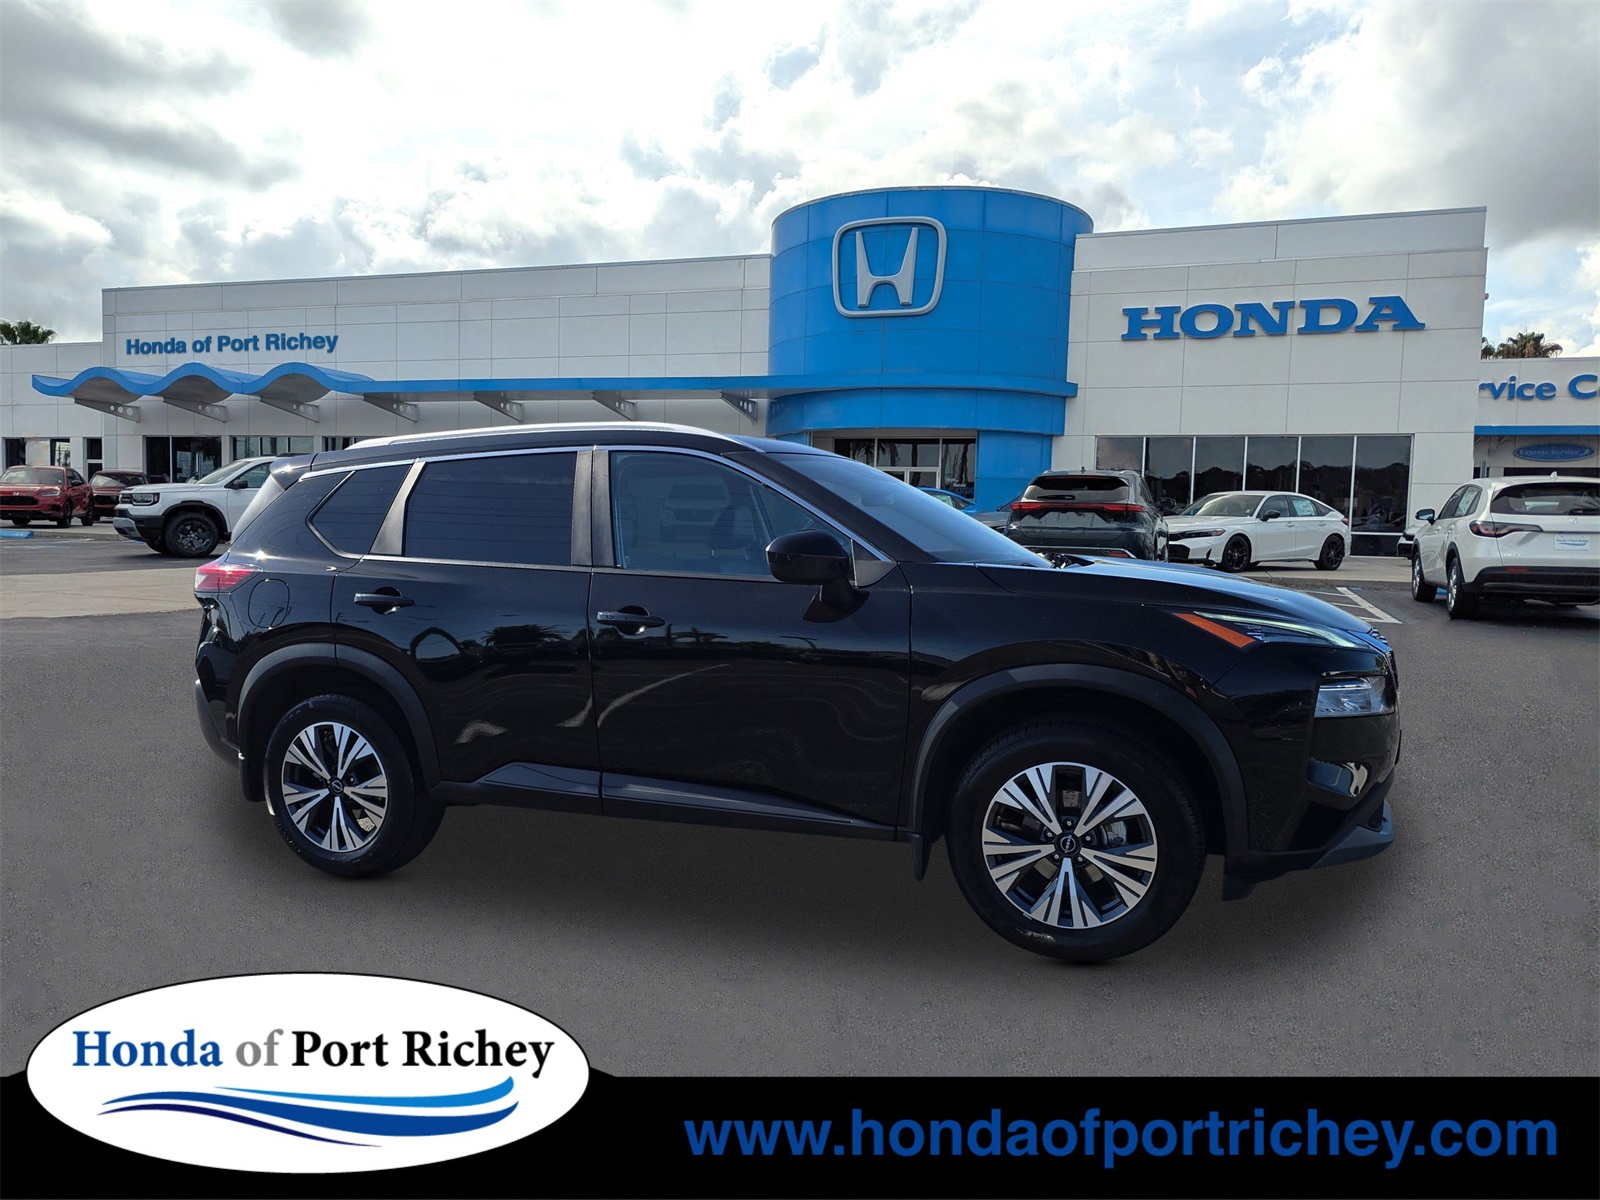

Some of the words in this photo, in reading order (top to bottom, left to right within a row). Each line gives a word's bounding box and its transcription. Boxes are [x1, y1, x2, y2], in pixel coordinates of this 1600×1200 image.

[1121, 295, 1426, 340] HONDA
[125, 336, 187, 355] Honda
[191, 335, 213, 354] of
[217, 335, 260, 353] Port
[265, 332, 339, 354] Richey
[1519, 449, 1549, 457] Express
[1550, 448, 1579, 456] Service
